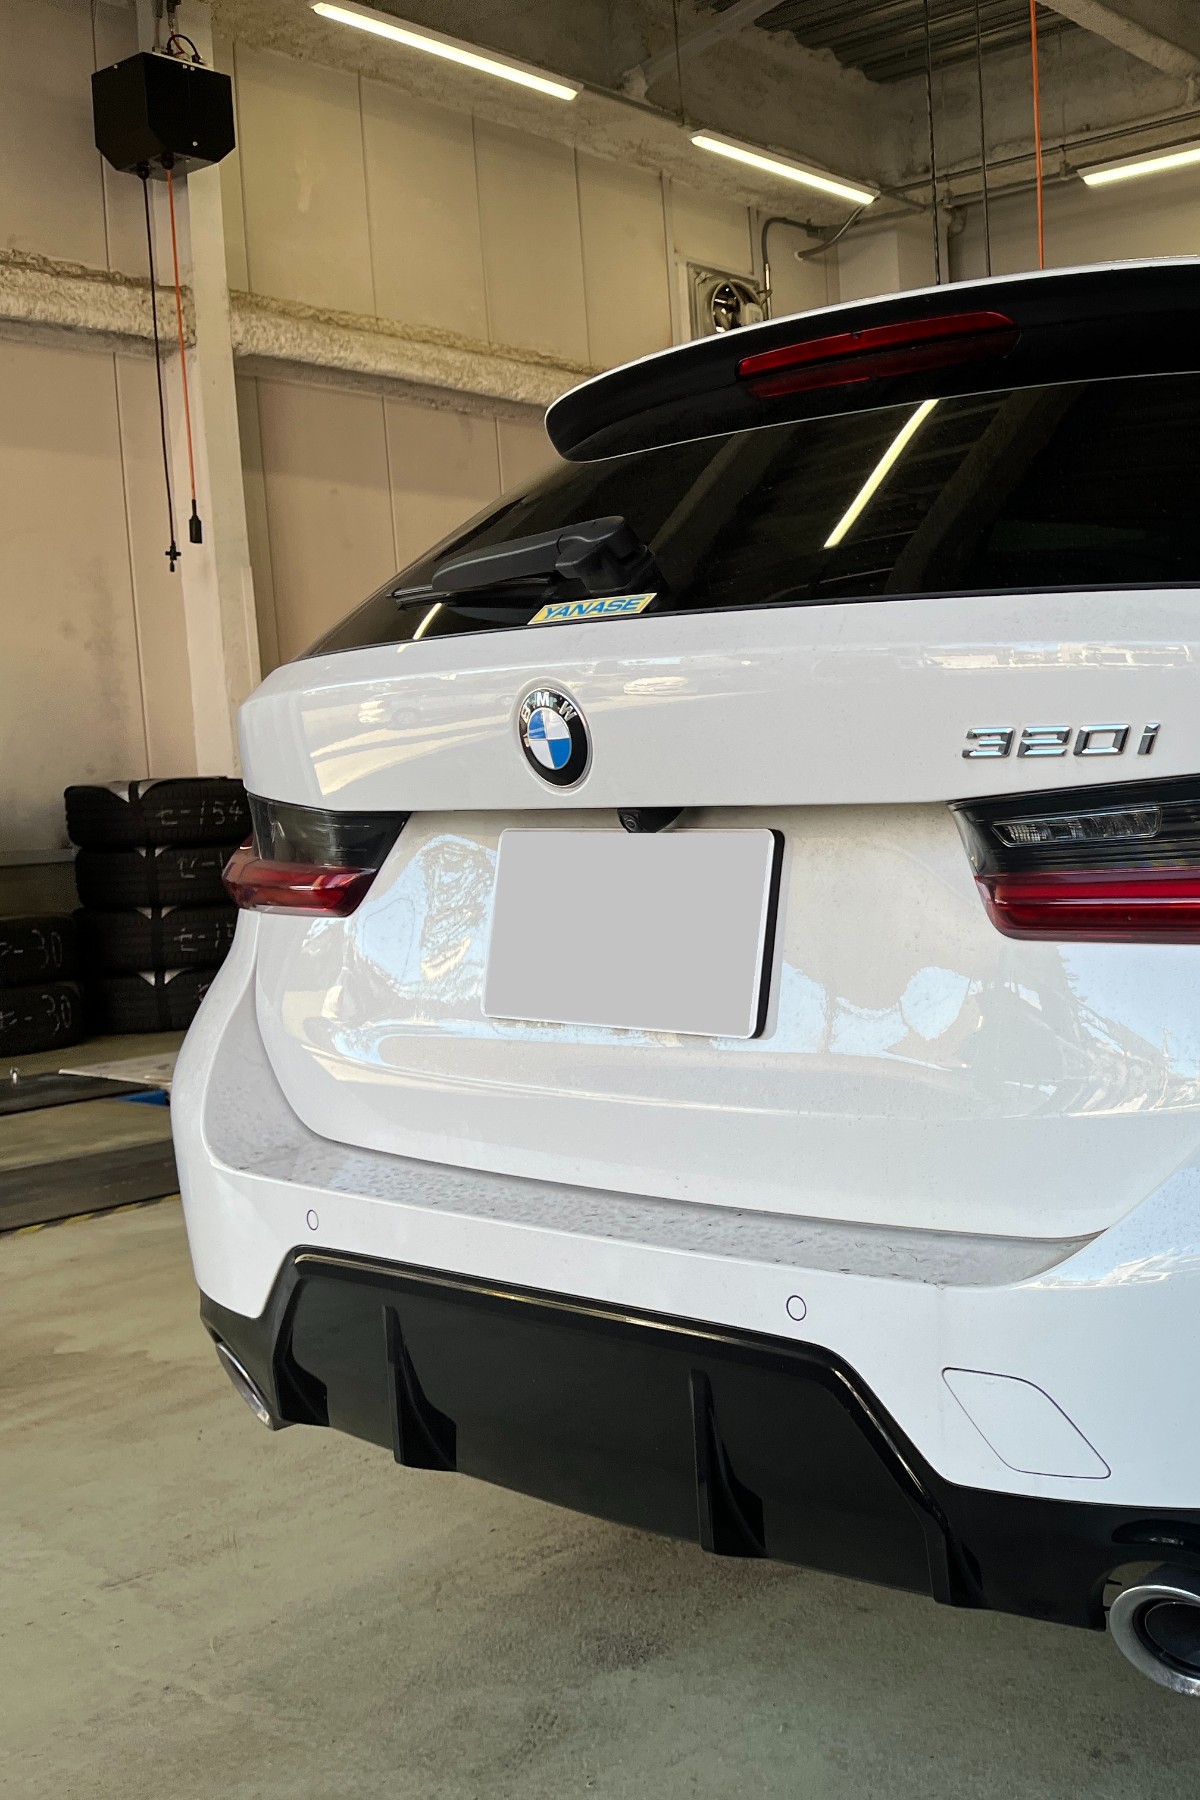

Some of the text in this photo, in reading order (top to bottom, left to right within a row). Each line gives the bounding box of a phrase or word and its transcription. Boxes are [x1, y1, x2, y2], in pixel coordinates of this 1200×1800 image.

[544, 597, 645, 619] YANASE
[520, 691, 578, 724] BMW
[961, 723, 1161, 758] 320i
